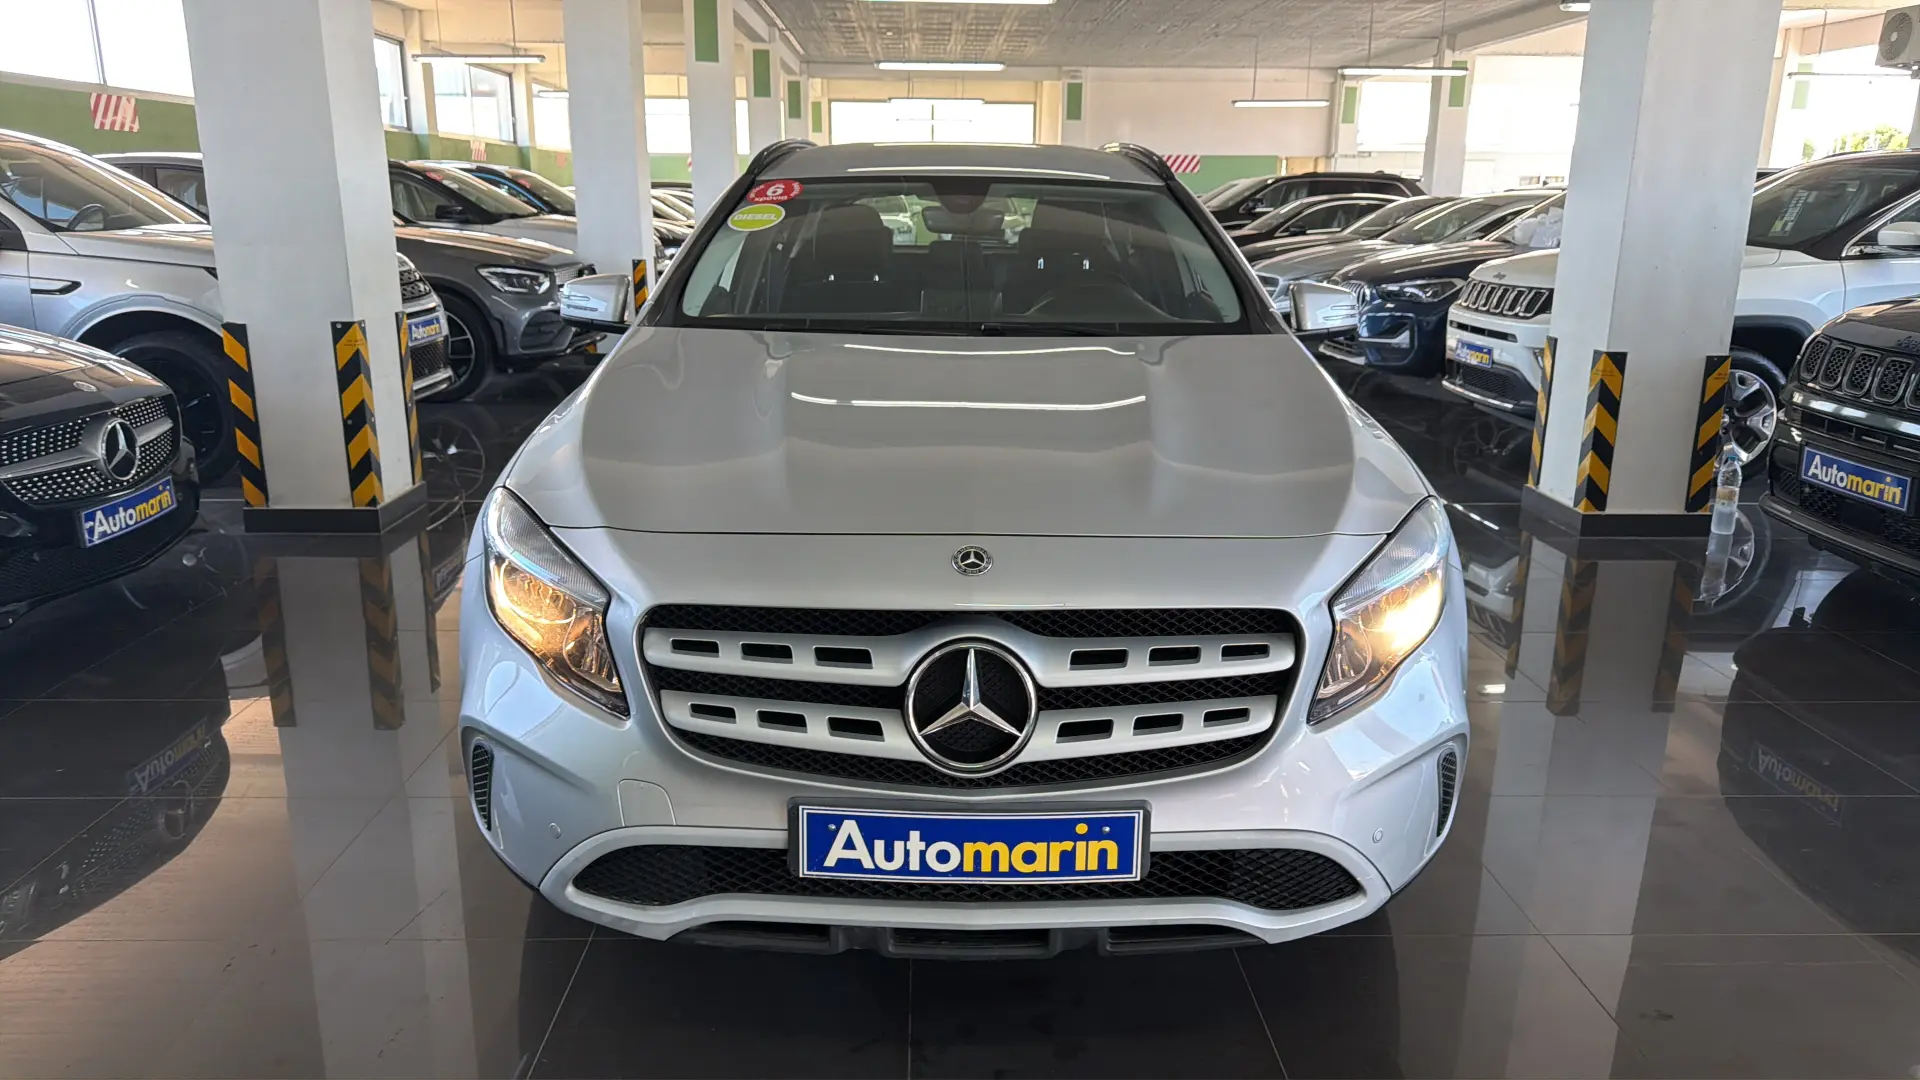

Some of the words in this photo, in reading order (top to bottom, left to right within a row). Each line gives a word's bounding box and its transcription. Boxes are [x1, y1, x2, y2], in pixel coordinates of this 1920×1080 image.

[766, 183, 785, 197] 6
[1807, 454, 1903, 504] Automarin
[93, 484, 172, 541] Automarin
[823, 819, 1119, 873] Automarin
